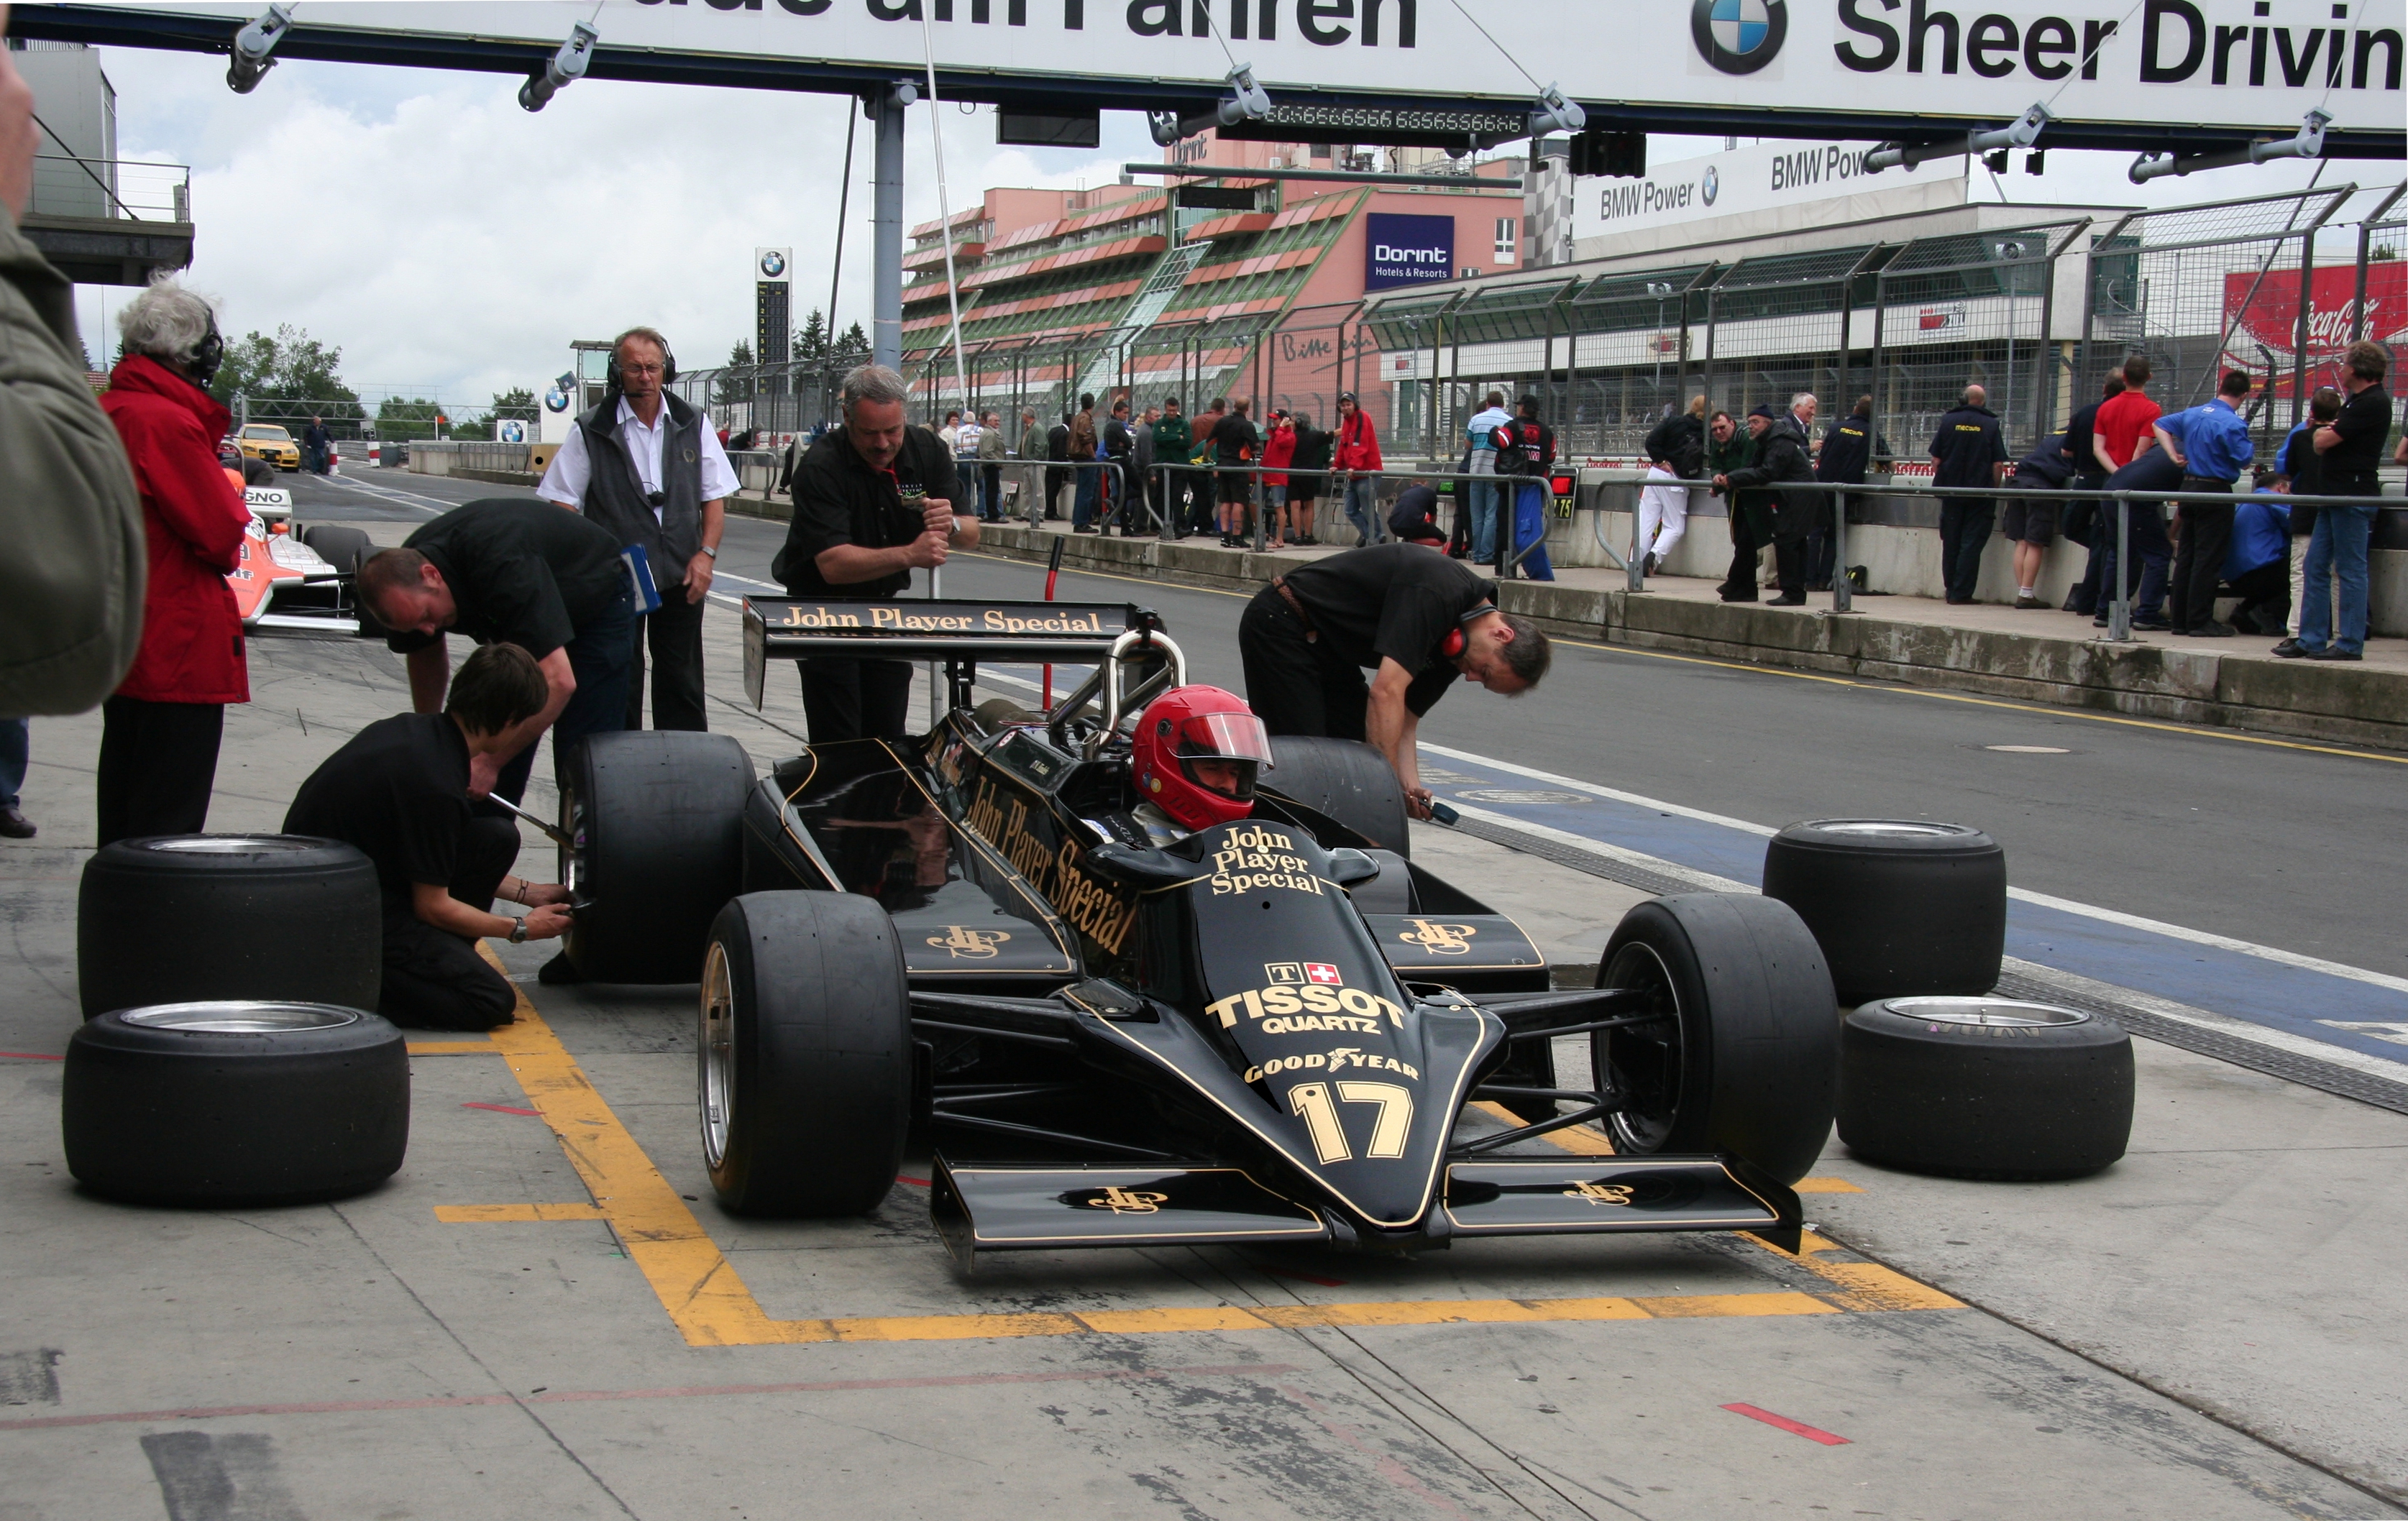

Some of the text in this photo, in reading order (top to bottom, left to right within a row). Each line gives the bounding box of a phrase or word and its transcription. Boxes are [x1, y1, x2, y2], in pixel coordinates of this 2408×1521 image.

[1833, 0, 2404, 91] Sheer Drivin
[1772, 145, 1865, 190] BMW Pow
[1601, 181, 1694, 221] BMW Power
[1375, 244, 1447, 263] Dorint
[1375, 267, 1447, 278] Hotels & Resorts
[1282, 334, 1332, 362] Bitte
[227, 567, 254, 581] lf
[782, 607, 1102, 633] John Player Special
[1222, 825, 1294, 850] John
[967, 775, 1137, 956] John Player Special
[1212, 847, 1309, 874] Player
[1211, 868, 1324, 896] Special
[1204, 985, 1406, 1030] TISSOT
[1262, 1015, 1382, 1035] QUARTZ
[1287, 1080, 1414, 1166] 17
